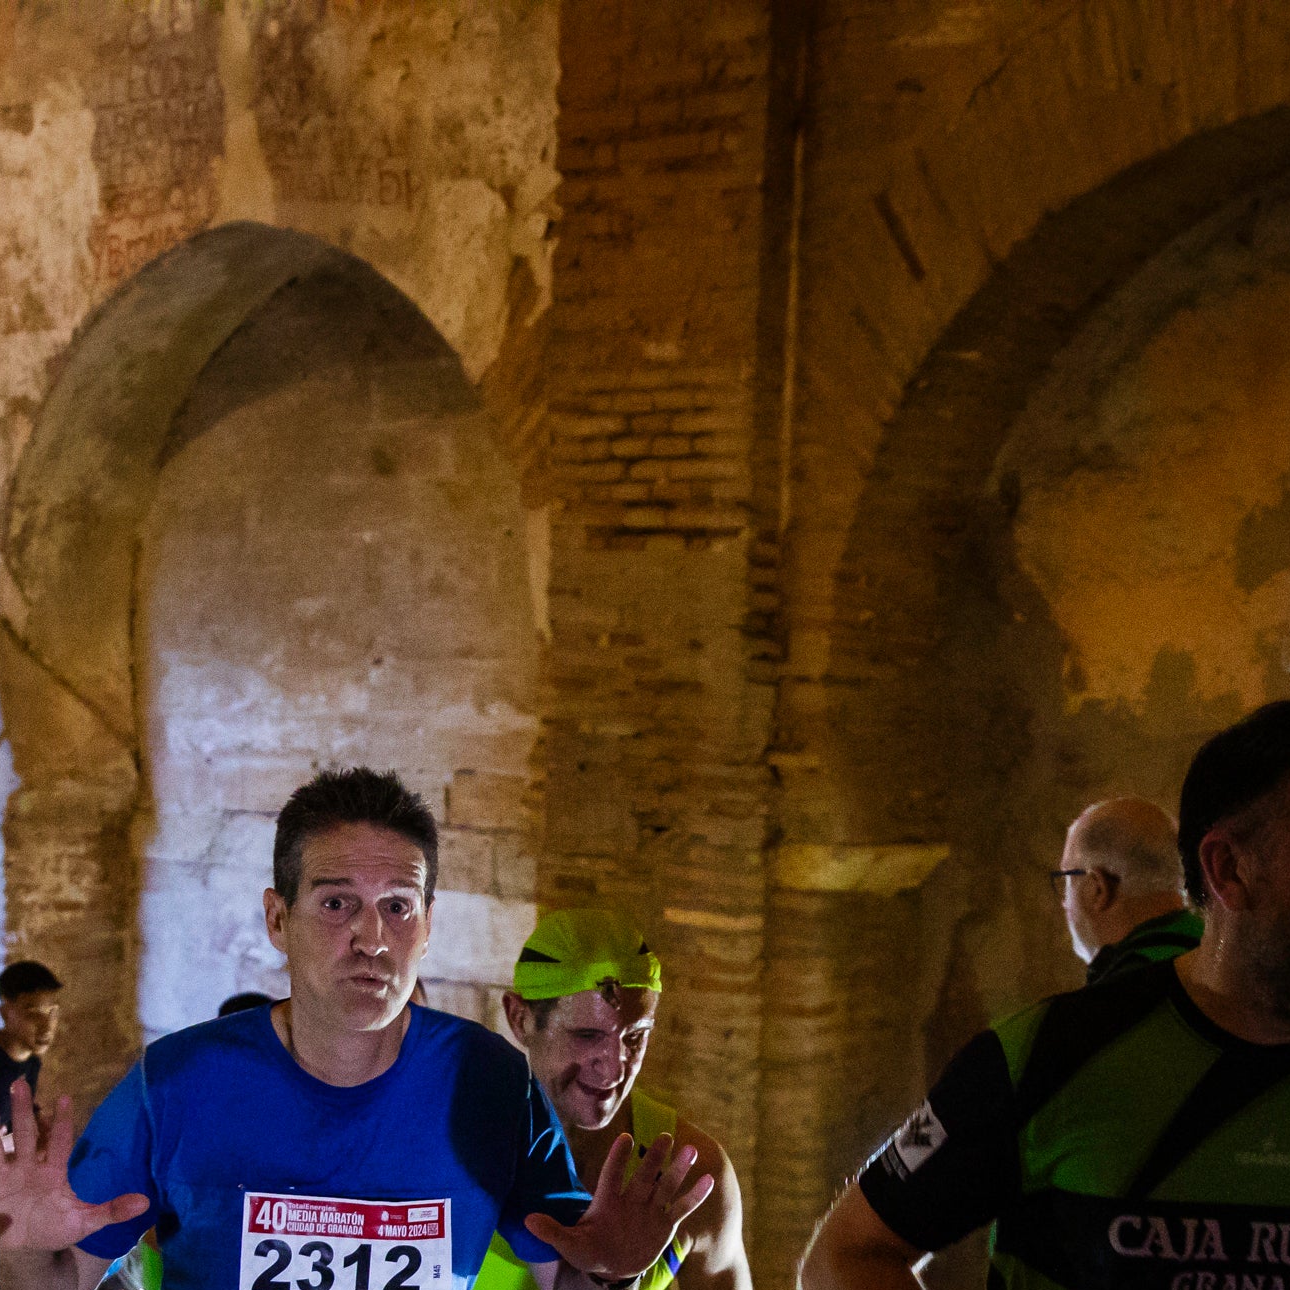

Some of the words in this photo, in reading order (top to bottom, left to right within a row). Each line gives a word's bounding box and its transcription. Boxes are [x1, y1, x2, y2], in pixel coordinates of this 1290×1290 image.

[255, 1200, 288, 1231] 40
[287, 1209, 318, 1223] MEDIA
[319, 1211, 365, 1227] MARATÓN
[286, 1221, 315, 1233] CIUDAD
[315, 1222, 326, 1234] DE
[327, 1223, 364, 1236] GRANADA
[377, 1224, 385, 1237] 4
[385, 1224, 407, 1238] MAYO
[408, 1223, 427, 1237] 2024
[1107, 1215, 1230, 1263] CAJA
